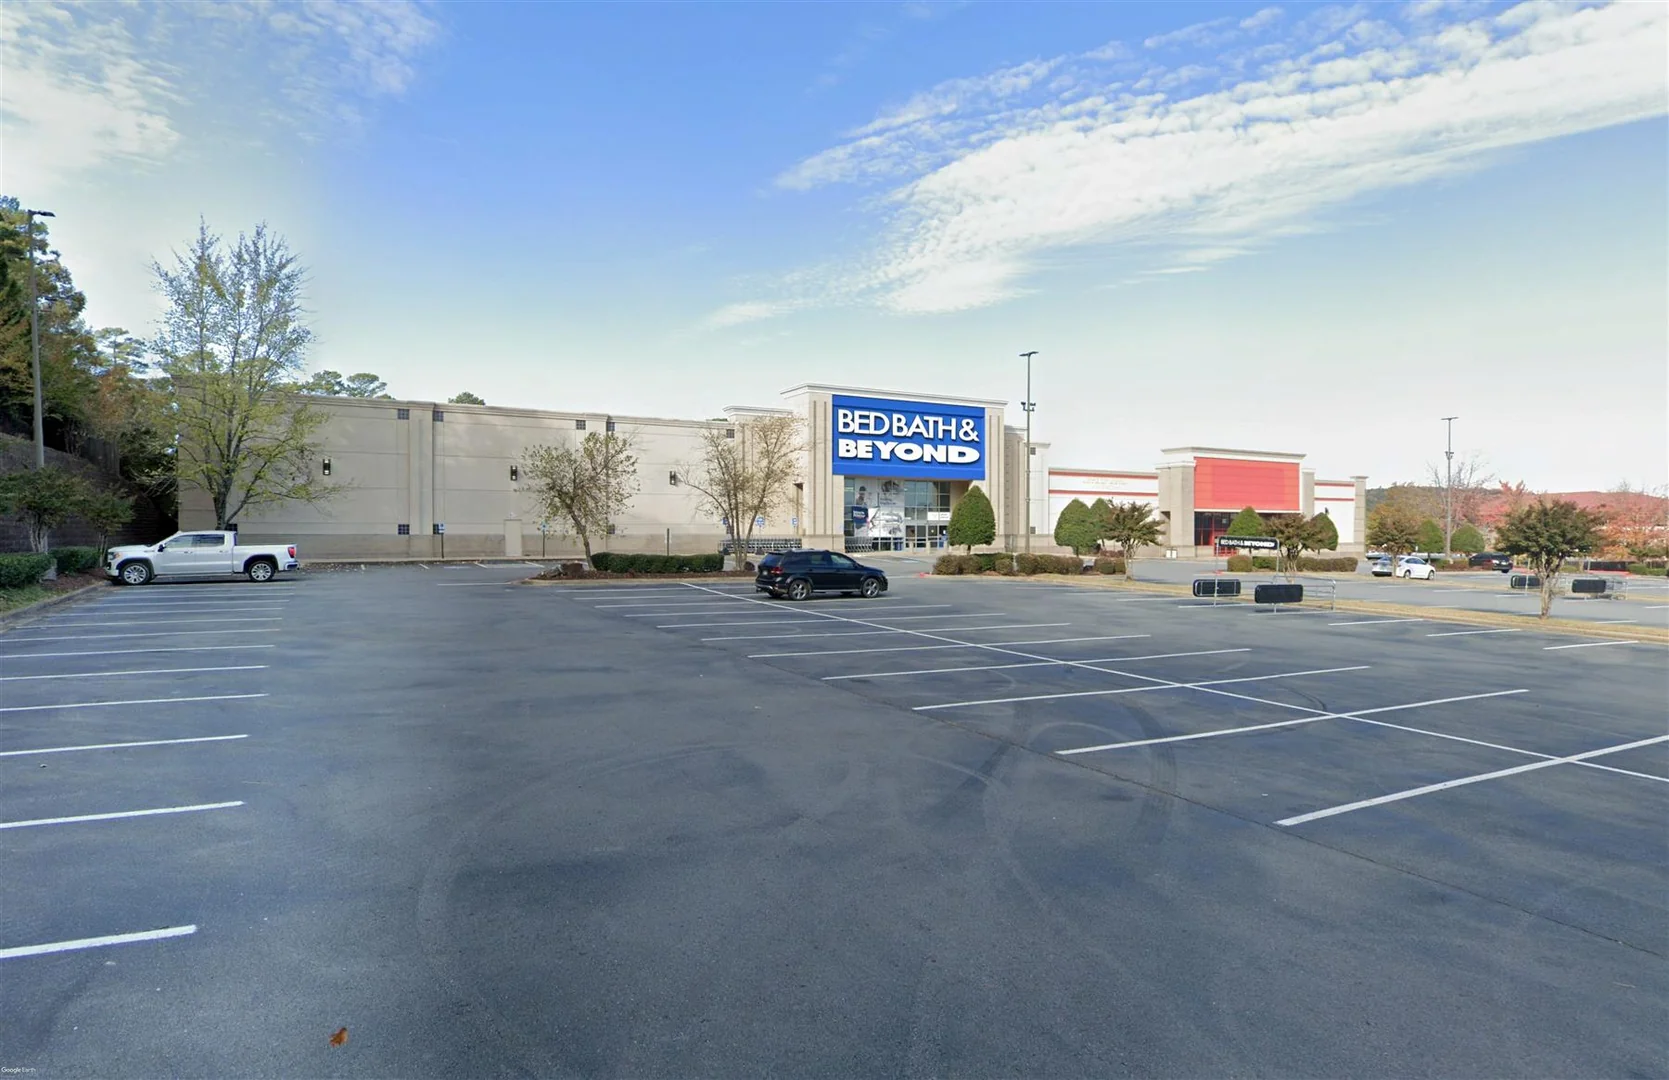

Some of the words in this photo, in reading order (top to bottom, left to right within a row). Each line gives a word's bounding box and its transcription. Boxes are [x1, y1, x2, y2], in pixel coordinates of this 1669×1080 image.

[838, 409, 890, 435] BED
[892, 413, 956, 440] BATH
[959, 418, 980, 442] &
[838, 438, 980, 464] BEYOND
